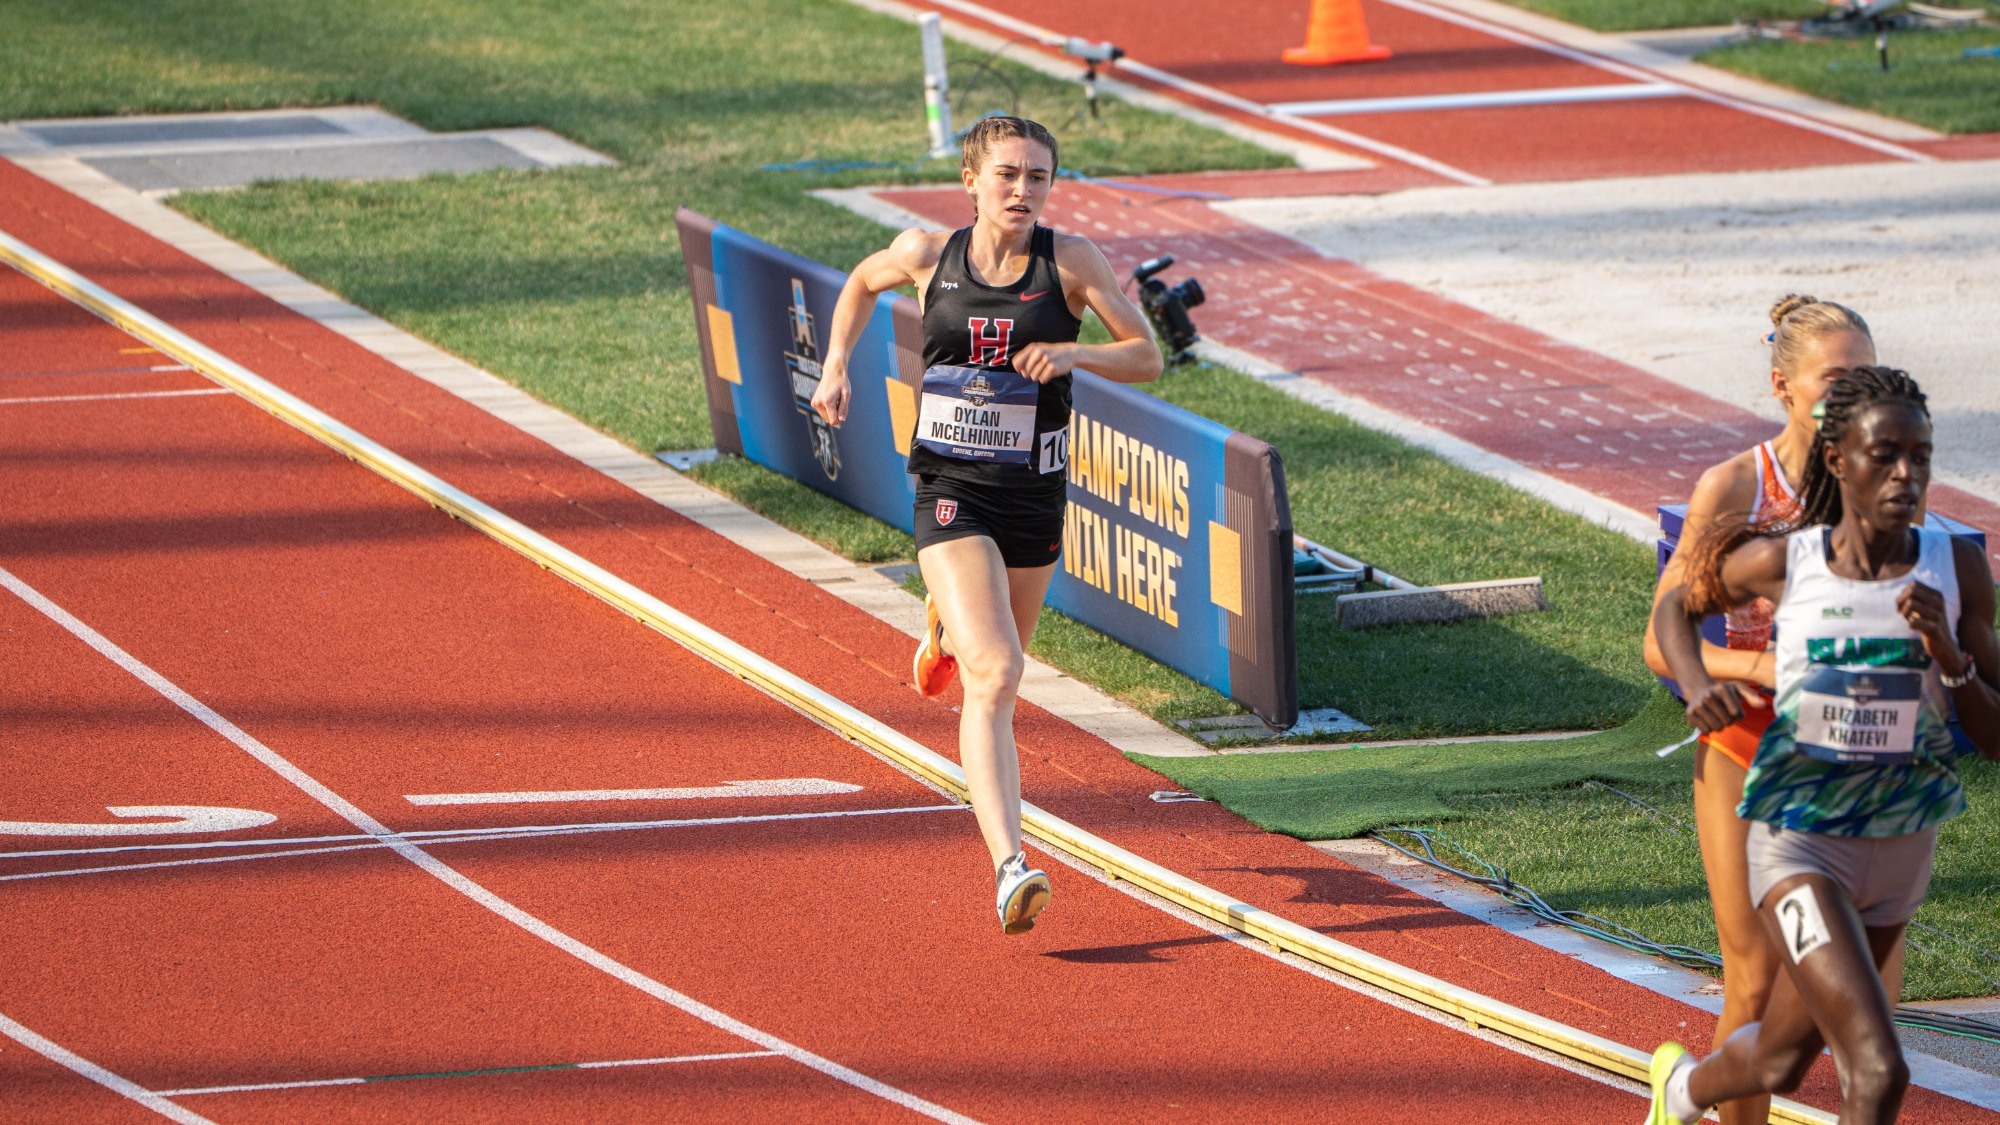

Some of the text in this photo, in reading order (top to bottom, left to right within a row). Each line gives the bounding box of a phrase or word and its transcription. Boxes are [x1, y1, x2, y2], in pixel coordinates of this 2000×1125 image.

[968, 317, 1014, 367] H
[954, 406, 1000, 427] DYLAN
[931, 422, 1021, 447] MCELHINNEY
[1044, 429, 1067, 468] 10
[940, 506, 952, 519] H
[1062, 501, 1111, 594] WIN
[1822, 705, 1898, 727] ELIZABETH
[1828, 728, 1889, 747] KHATEVI
[1782, 899, 1818, 953] 2
